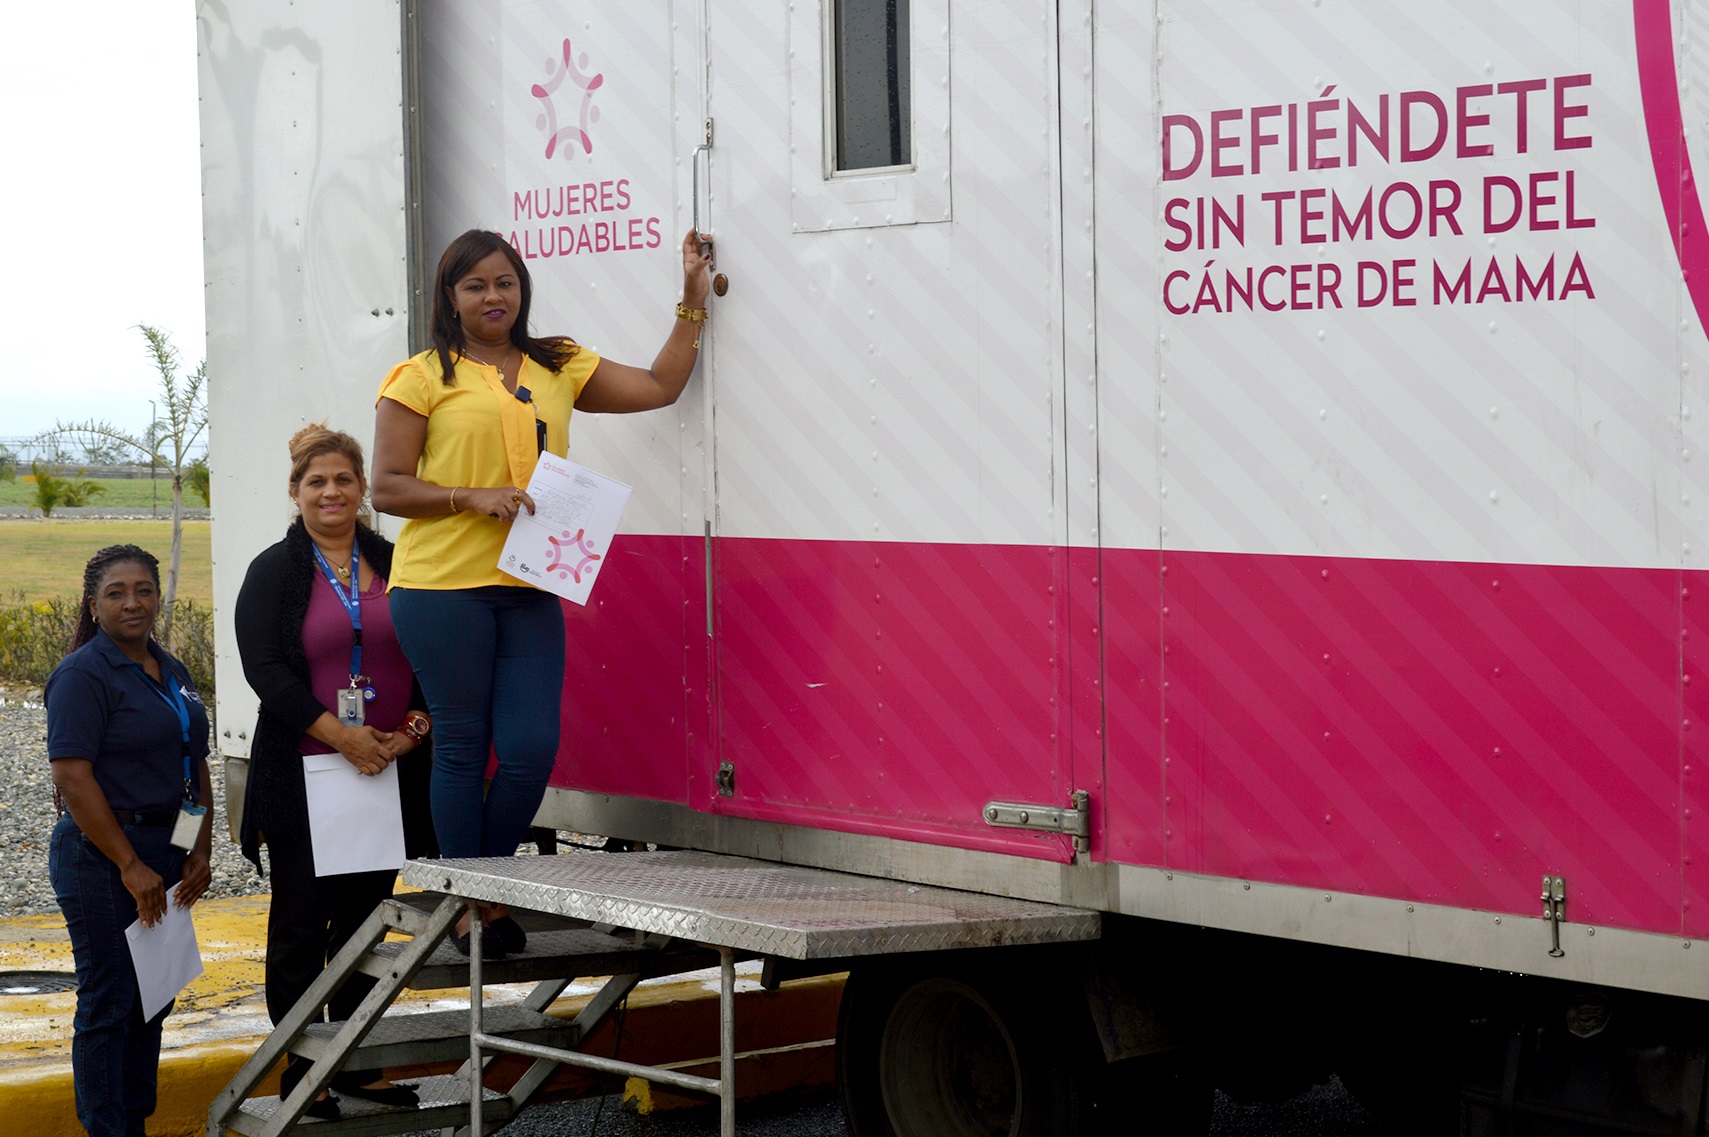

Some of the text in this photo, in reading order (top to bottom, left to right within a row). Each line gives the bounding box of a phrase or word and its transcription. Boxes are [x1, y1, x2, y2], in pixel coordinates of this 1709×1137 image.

[1162, 73, 1593, 181] DEFIÉNDETE
[514, 179, 631, 221] MUJERES
[1164, 169, 1597, 252] SIN TEMOR DEL
[495, 217, 661, 259] ALUDABLES
[1163, 250, 1596, 315] CÁNCER DE MAMA
